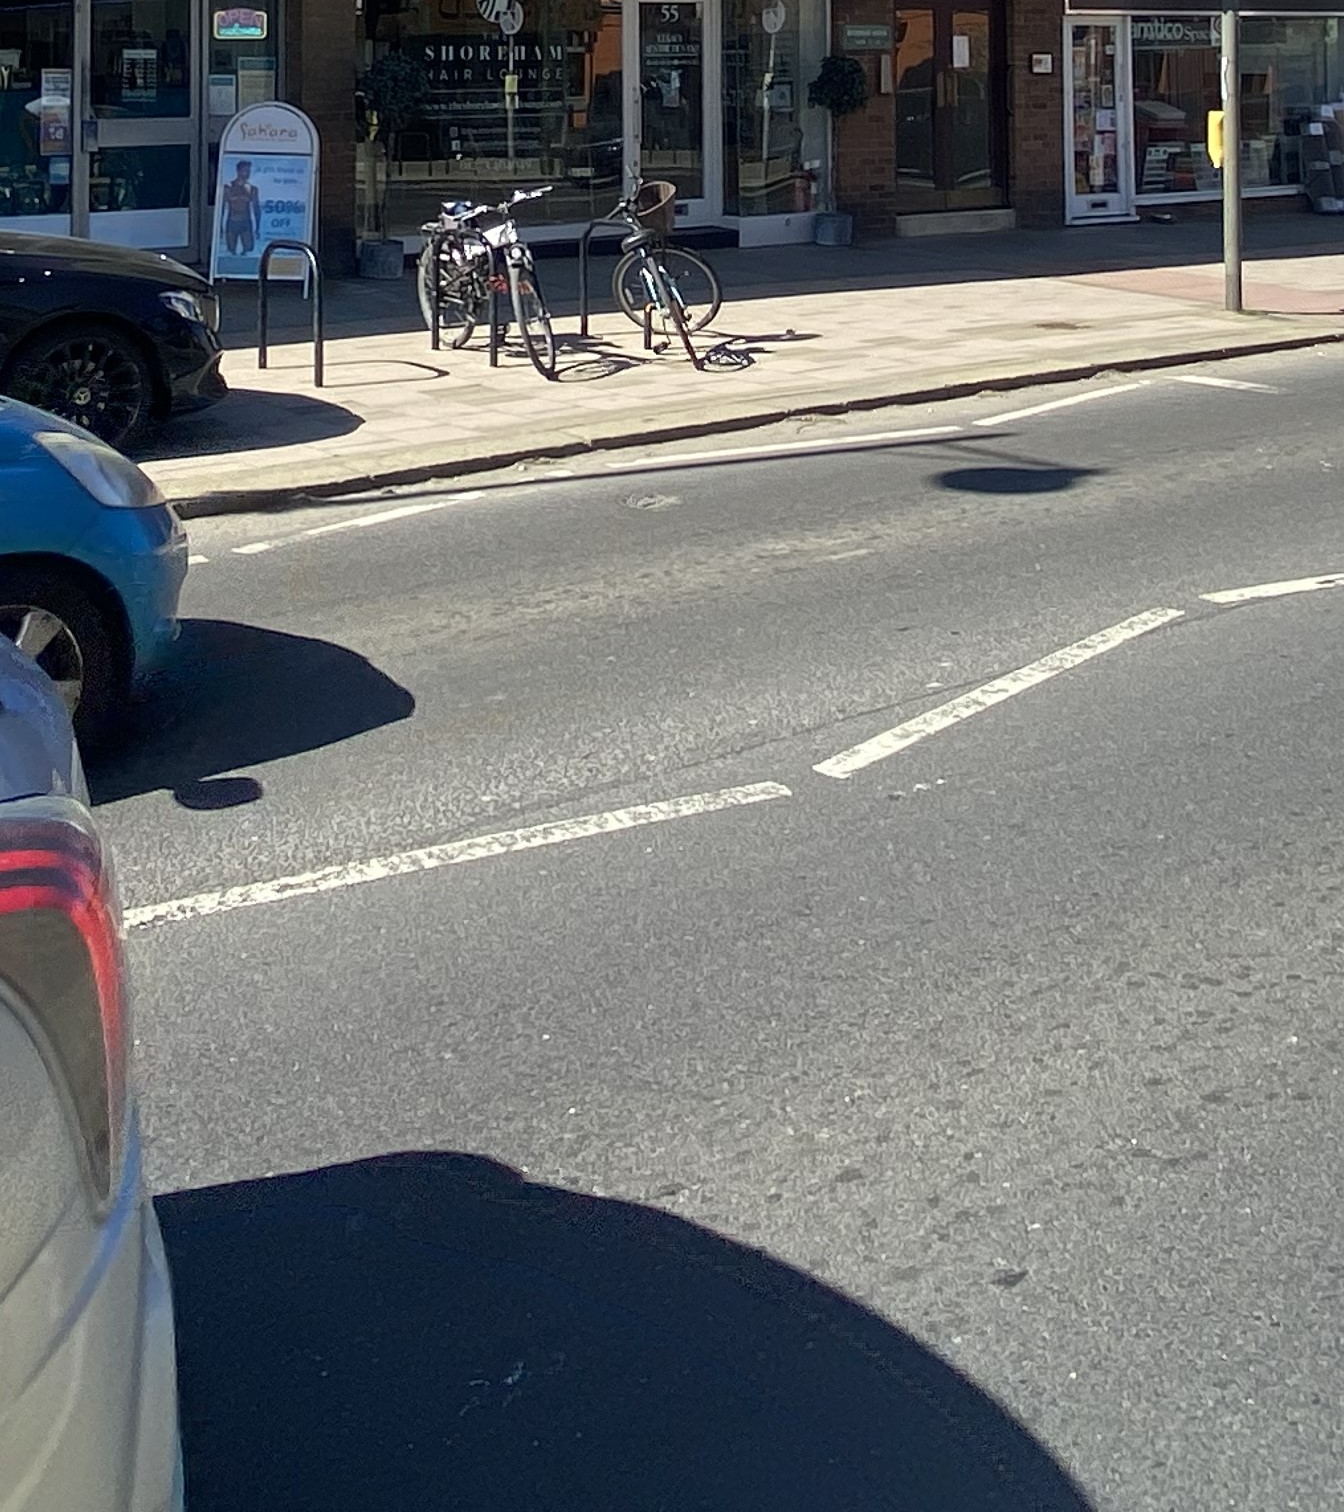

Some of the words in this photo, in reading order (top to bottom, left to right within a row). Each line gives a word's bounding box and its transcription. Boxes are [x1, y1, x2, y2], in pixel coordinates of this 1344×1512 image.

[218, 11, 262, 26] OPEN
[659, 4, 680, 23] 55
[423, 45, 563, 62] SHOREHAM
[240, 121, 298, 140] Sahara
